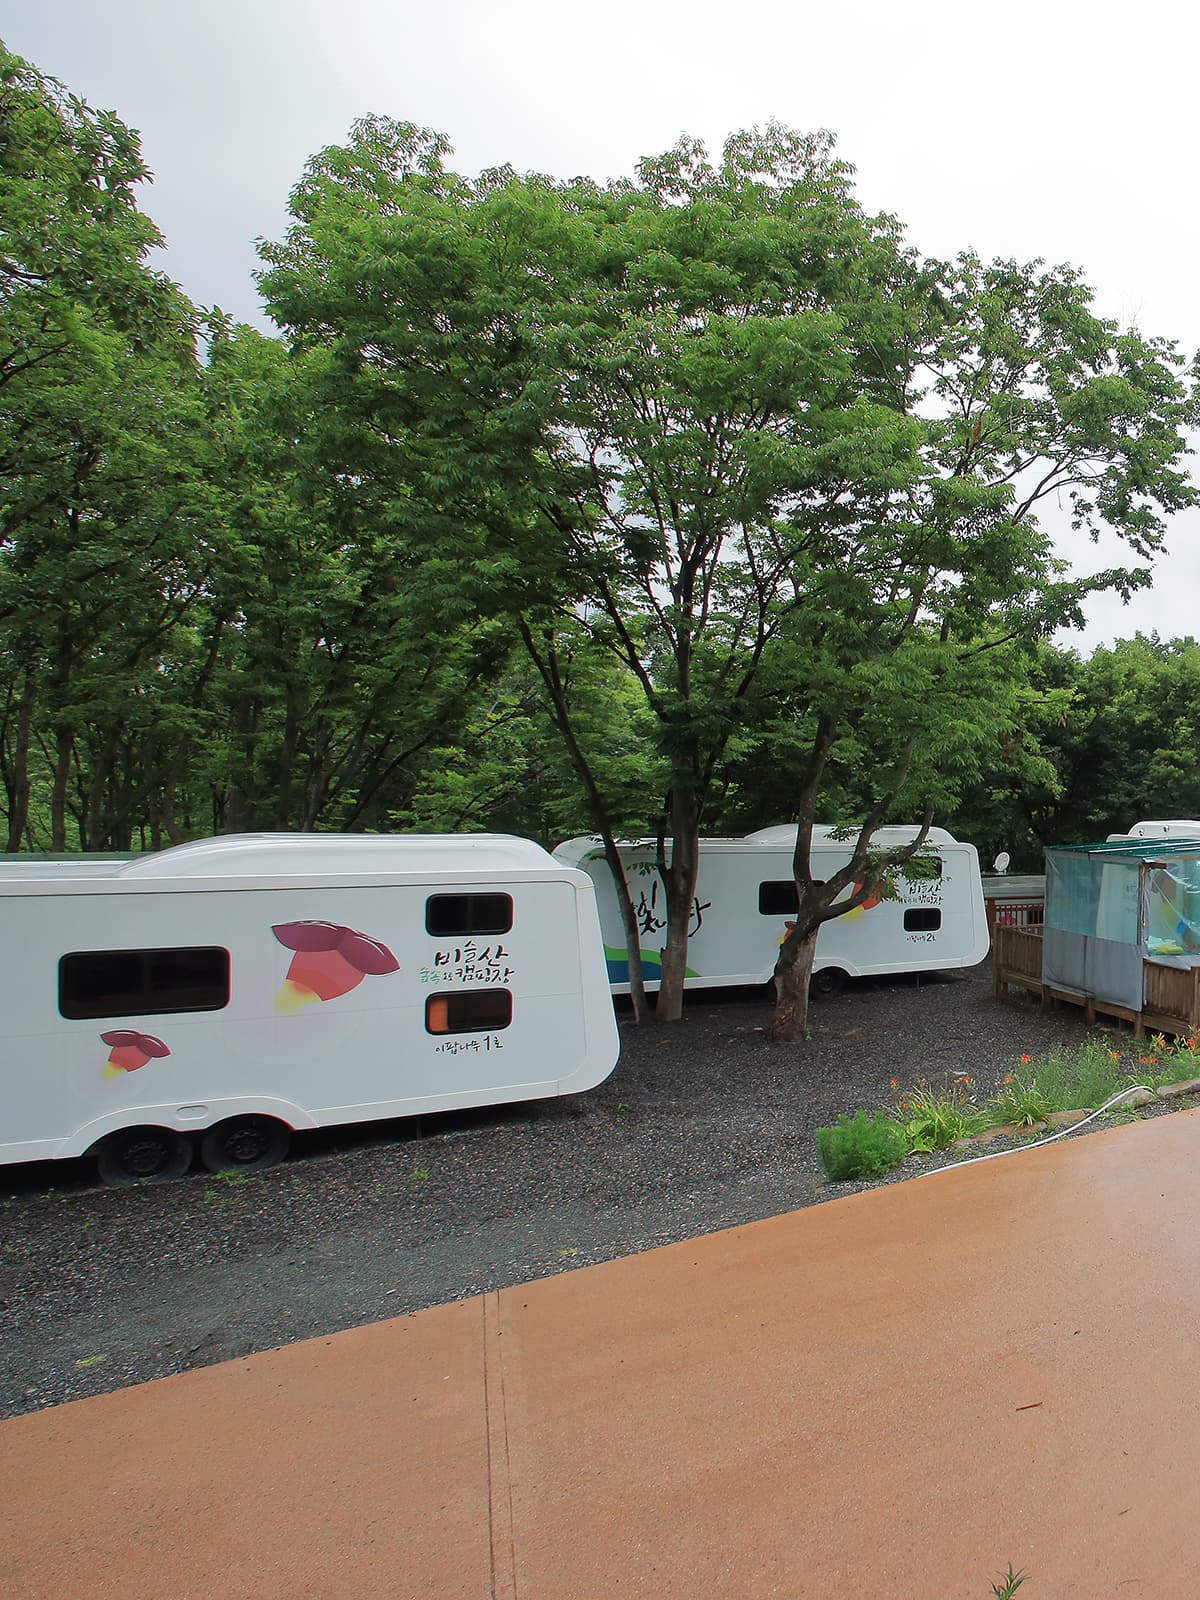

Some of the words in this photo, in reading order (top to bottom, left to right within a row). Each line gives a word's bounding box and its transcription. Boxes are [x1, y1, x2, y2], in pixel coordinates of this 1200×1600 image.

[434, 940, 509, 967] 비슬산
[455, 964, 515, 984] 캠핑장
[483, 1034, 504, 1051] 1호
